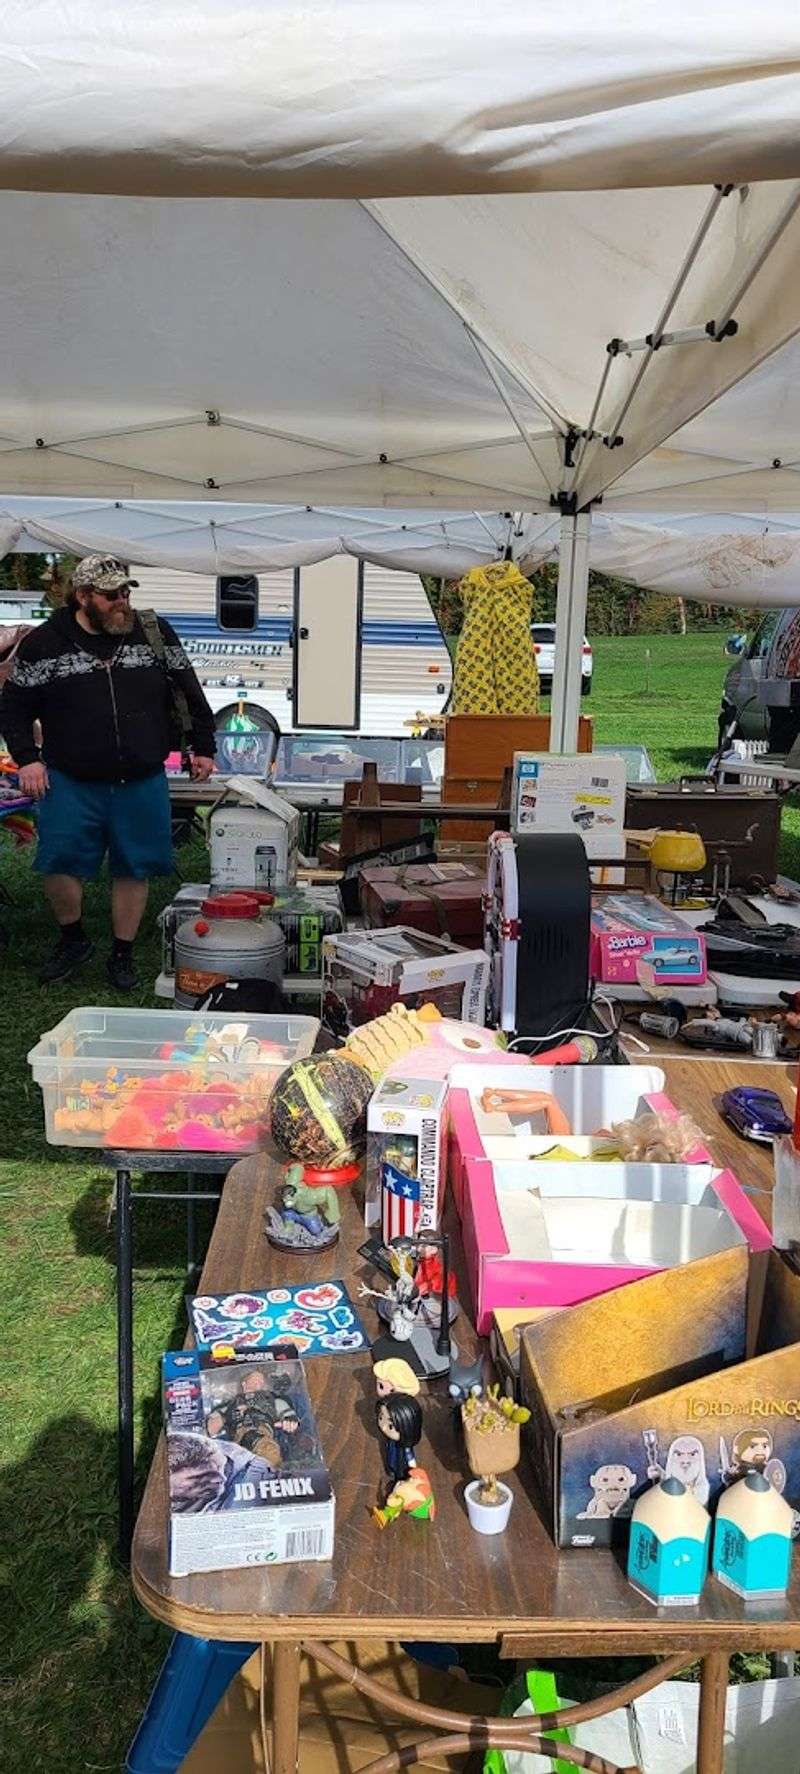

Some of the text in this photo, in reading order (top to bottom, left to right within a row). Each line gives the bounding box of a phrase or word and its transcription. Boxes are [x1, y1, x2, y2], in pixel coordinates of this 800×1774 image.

[608, 935, 648, 951] Barbie
[686, 1398, 733, 1422] LORD
[233, 1477, 315, 1501] JD FENIX
